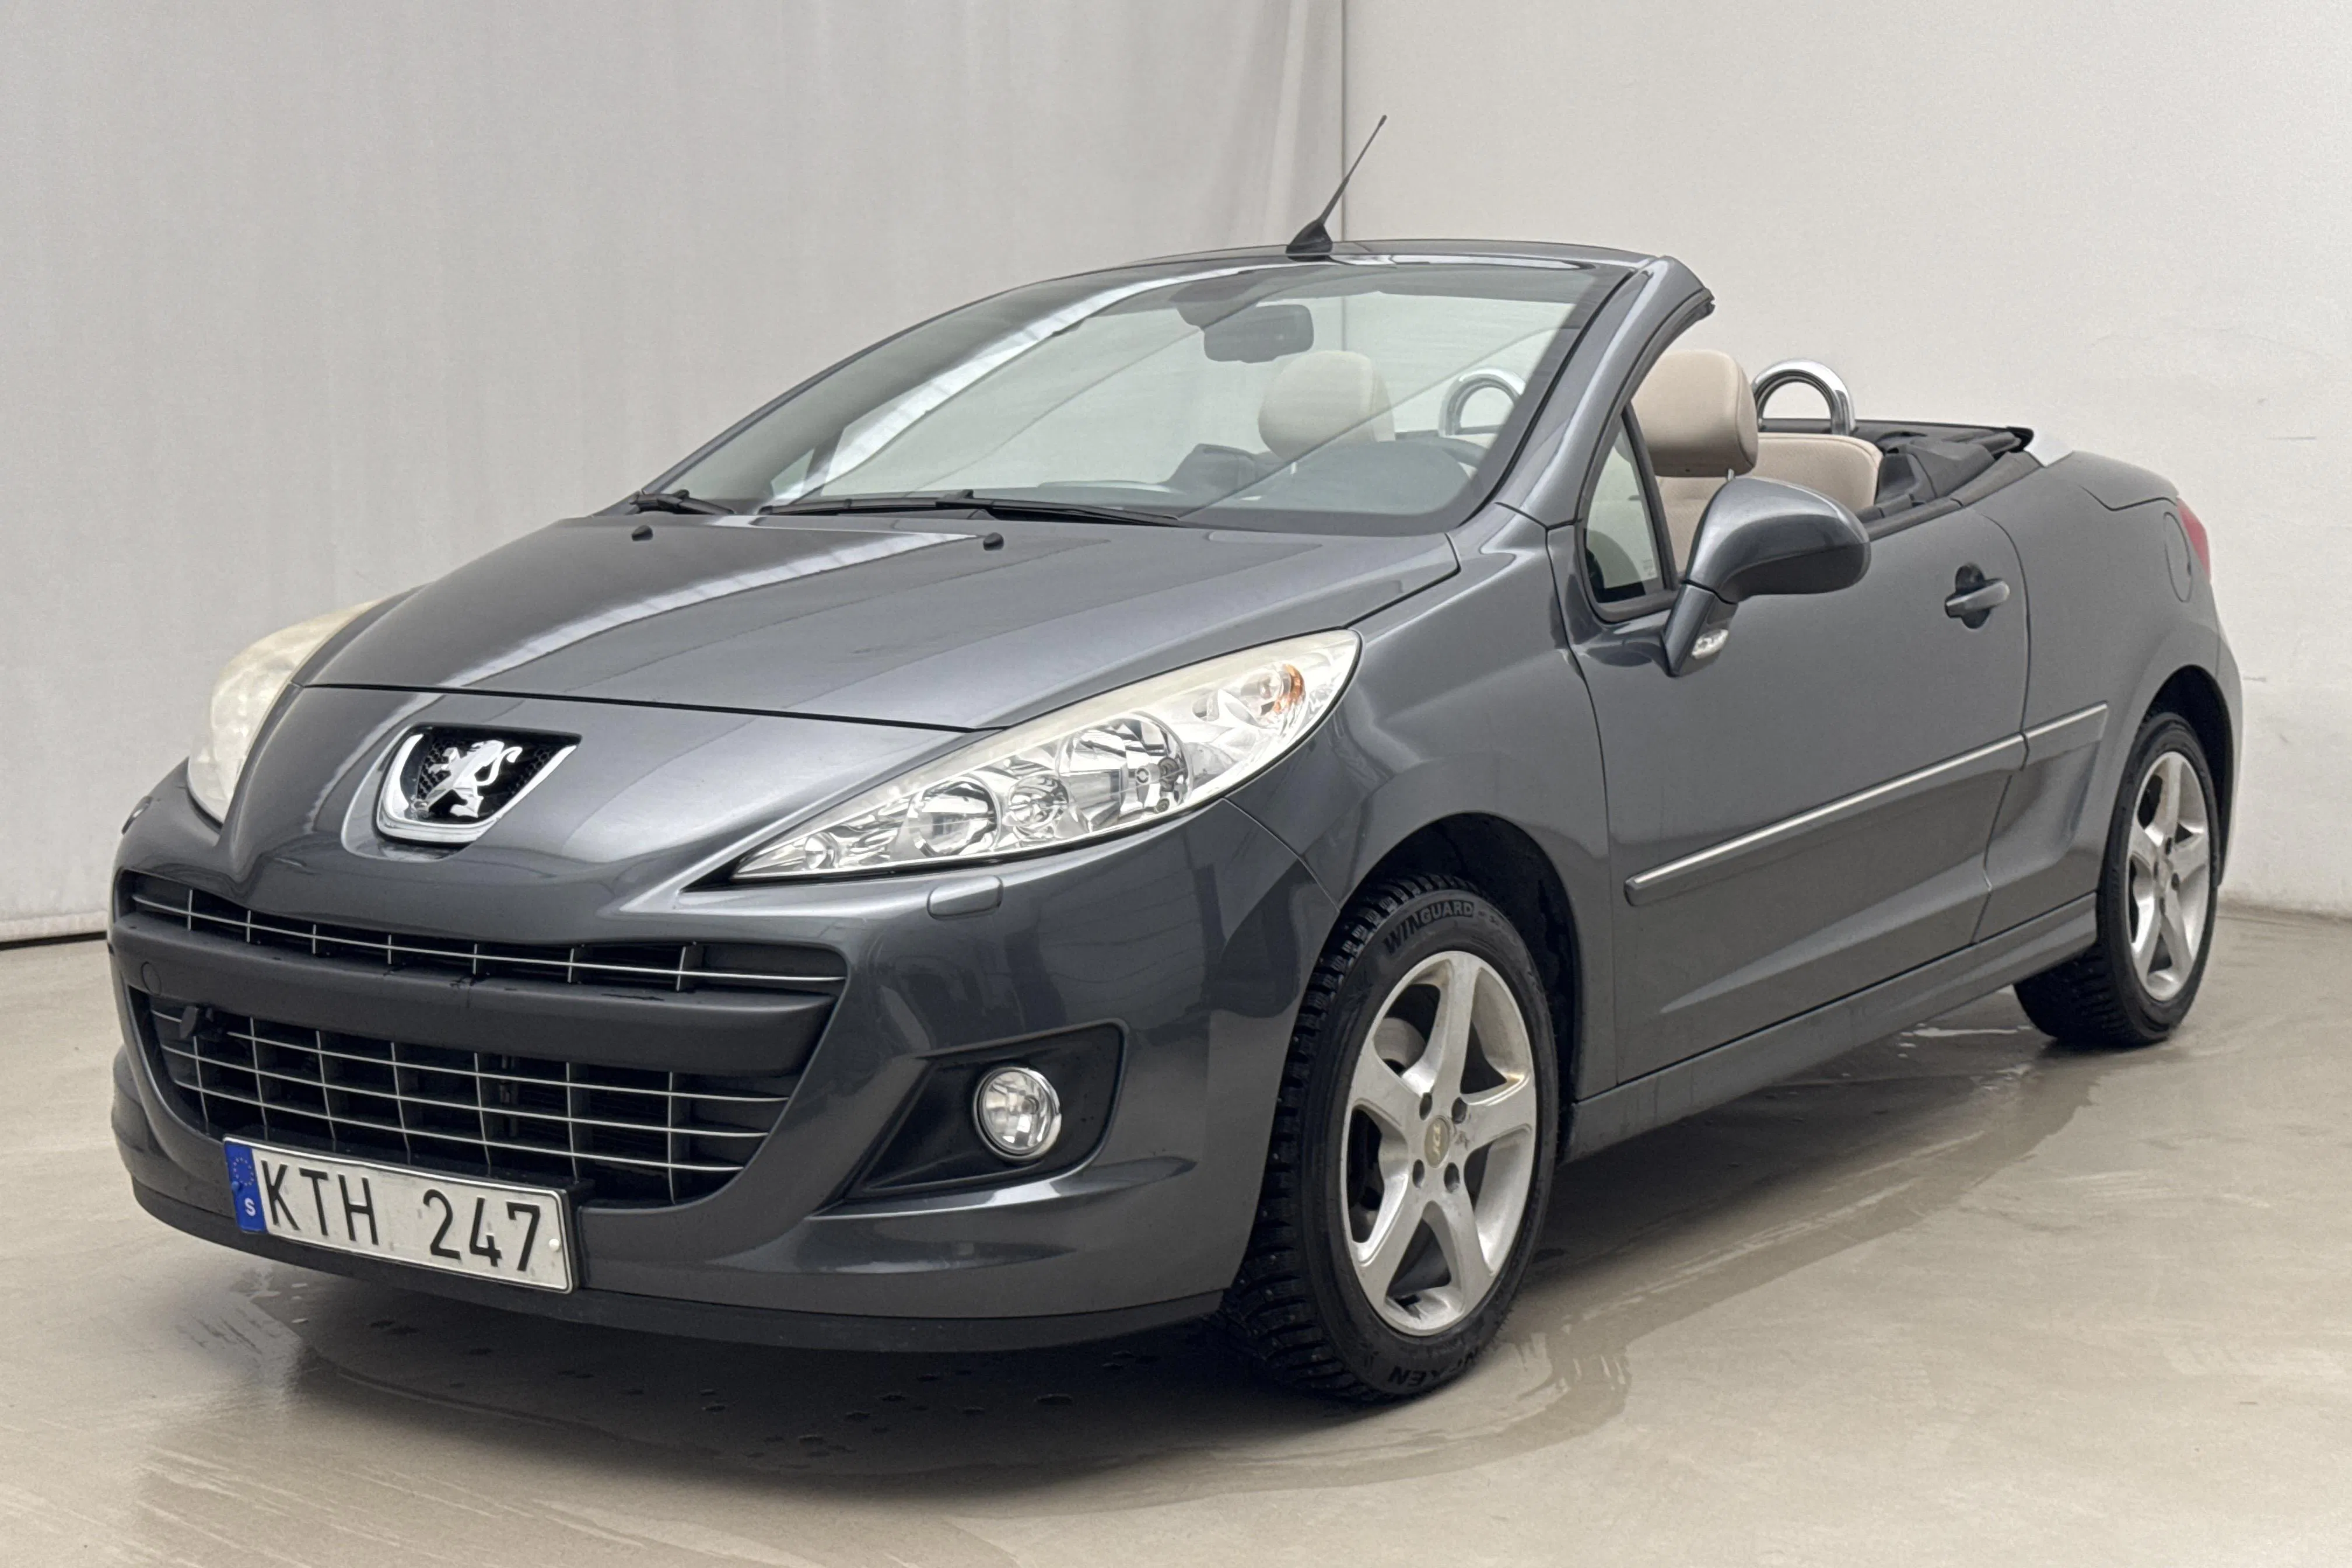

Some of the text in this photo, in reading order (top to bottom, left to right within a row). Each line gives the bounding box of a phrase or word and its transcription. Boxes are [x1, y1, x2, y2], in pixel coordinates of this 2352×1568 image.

[1383, 900, 1474, 955] WINGUARD
[244, 1198, 256, 1217] S
[261, 1160, 541, 1272] KTH 247
